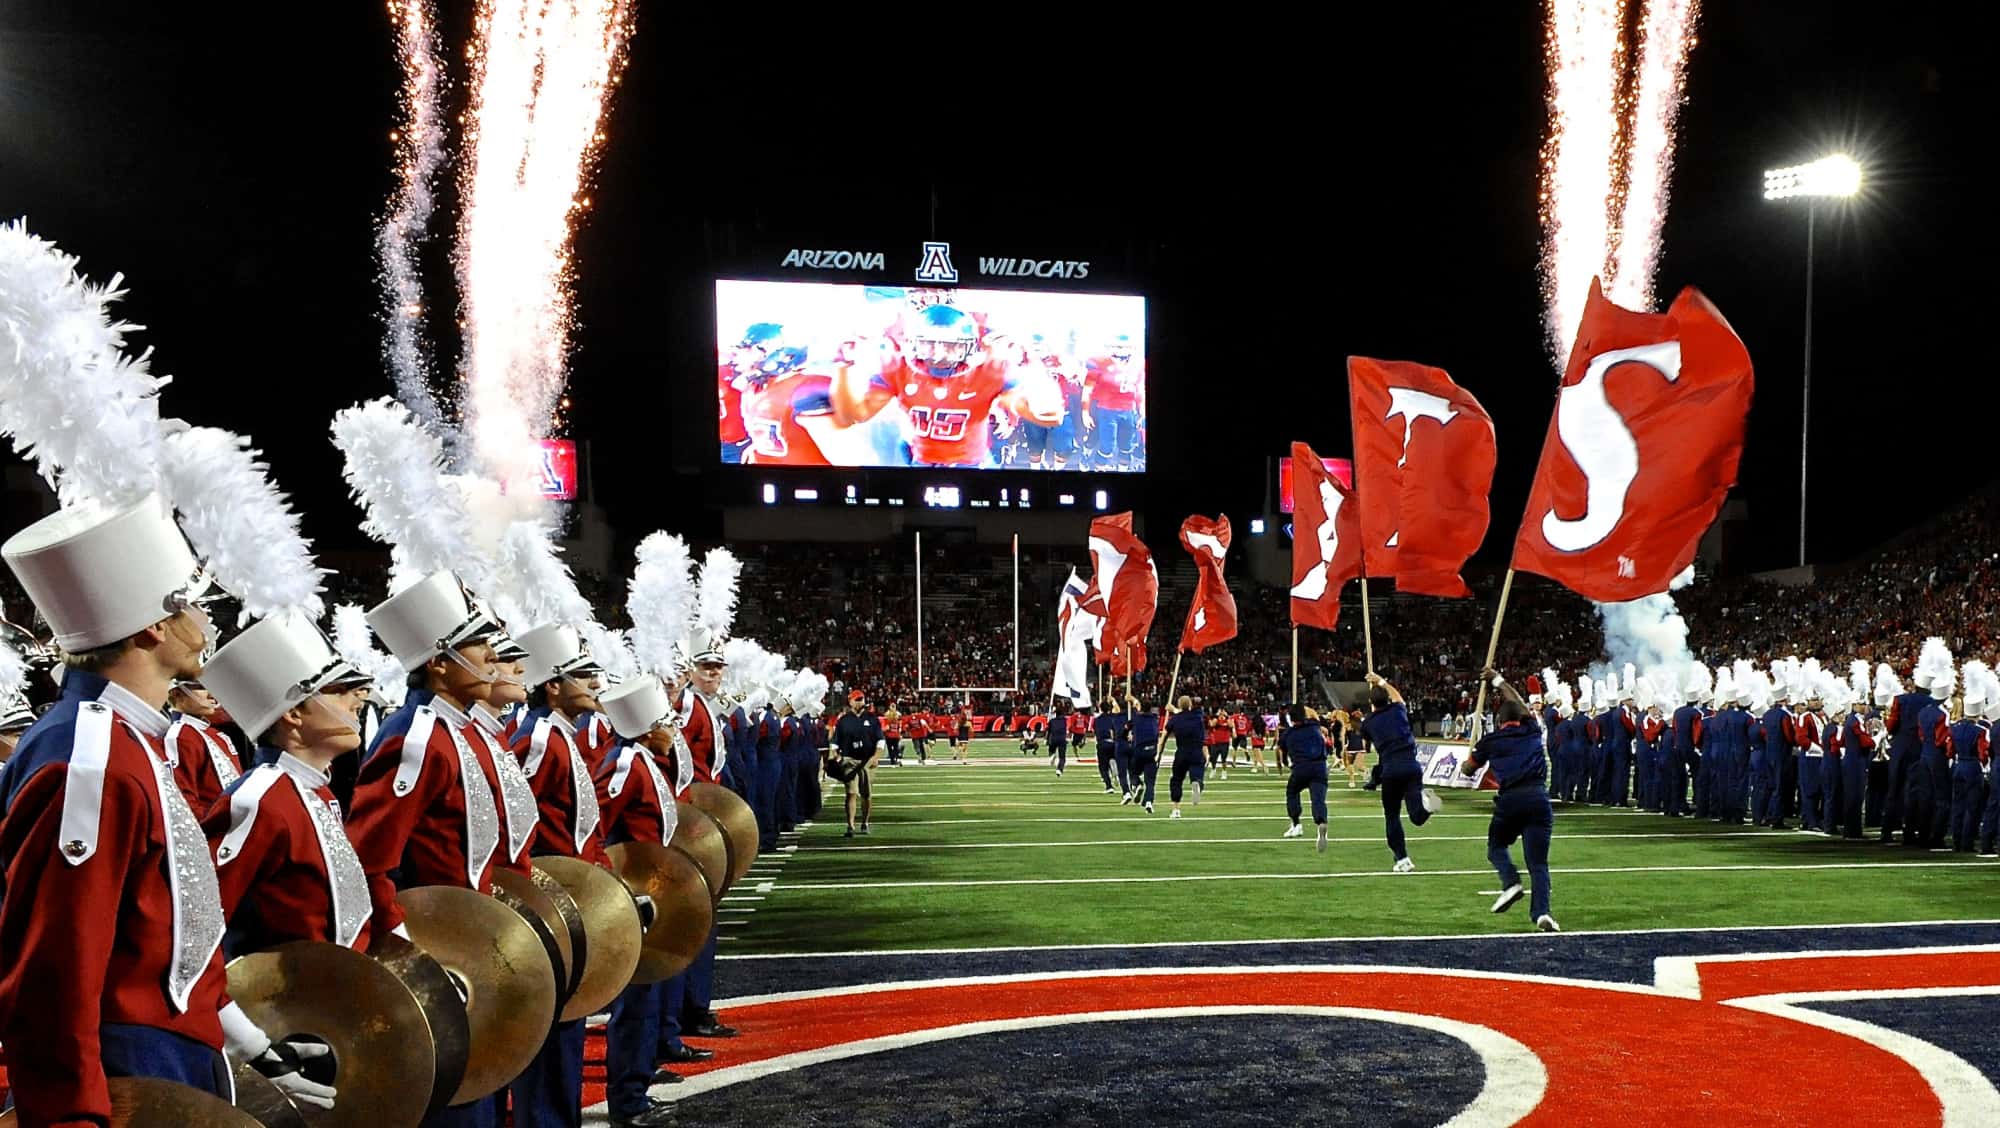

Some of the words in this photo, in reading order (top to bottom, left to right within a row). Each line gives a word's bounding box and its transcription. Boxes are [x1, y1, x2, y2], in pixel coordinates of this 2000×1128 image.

[781, 248, 885, 271] ARIZONA
[915, 241, 958, 283] A
[979, 256, 1090, 280] WILDCATS
[1542, 340, 1682, 553] S
